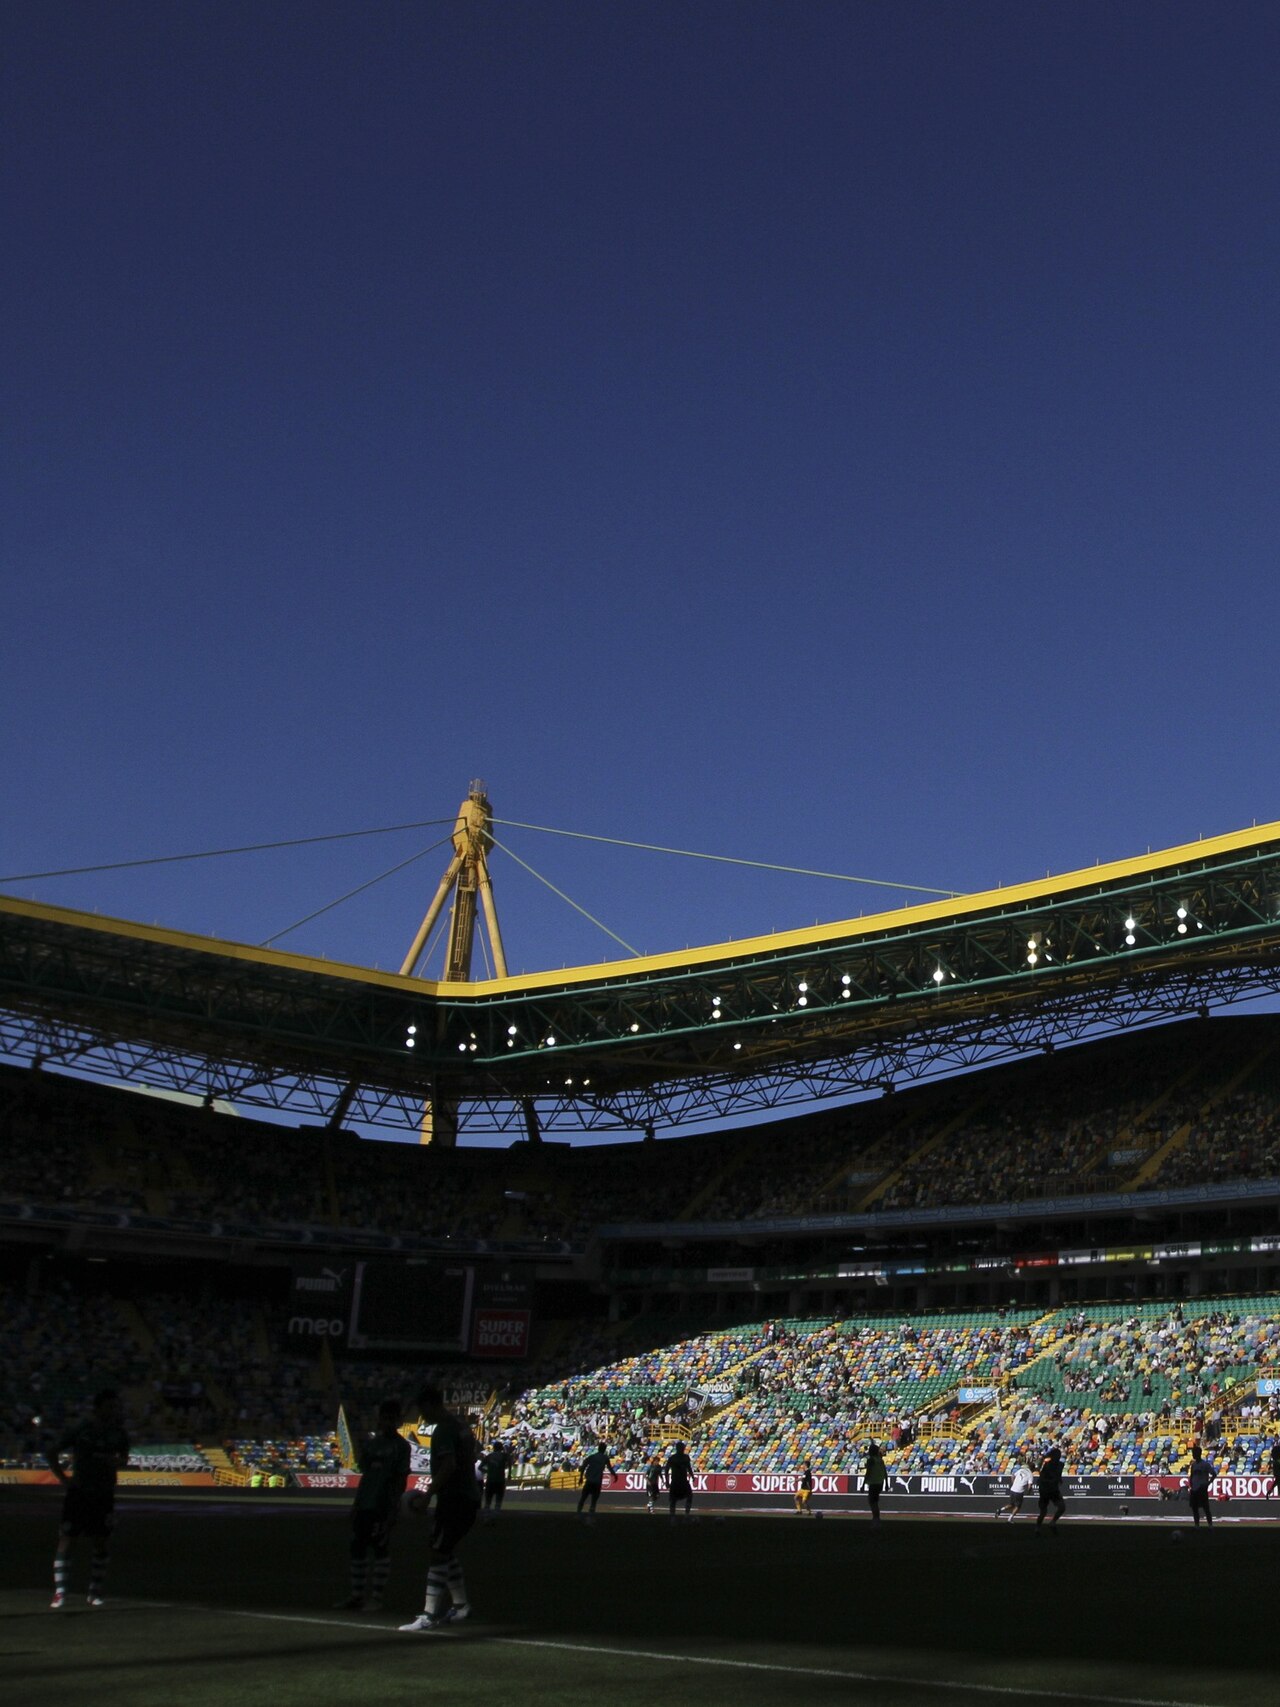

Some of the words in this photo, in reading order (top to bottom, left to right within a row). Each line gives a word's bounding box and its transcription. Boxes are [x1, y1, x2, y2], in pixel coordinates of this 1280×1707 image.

[288, 1316, 345, 1337] meo
[478, 1320, 525, 1333] SUPER
[478, 1333, 521, 1346] BOCK
[307, 1475, 348, 1484] SUPER
[752, 1475, 795, 1491] SUPER
[921, 1477, 955, 1492] PUMA
